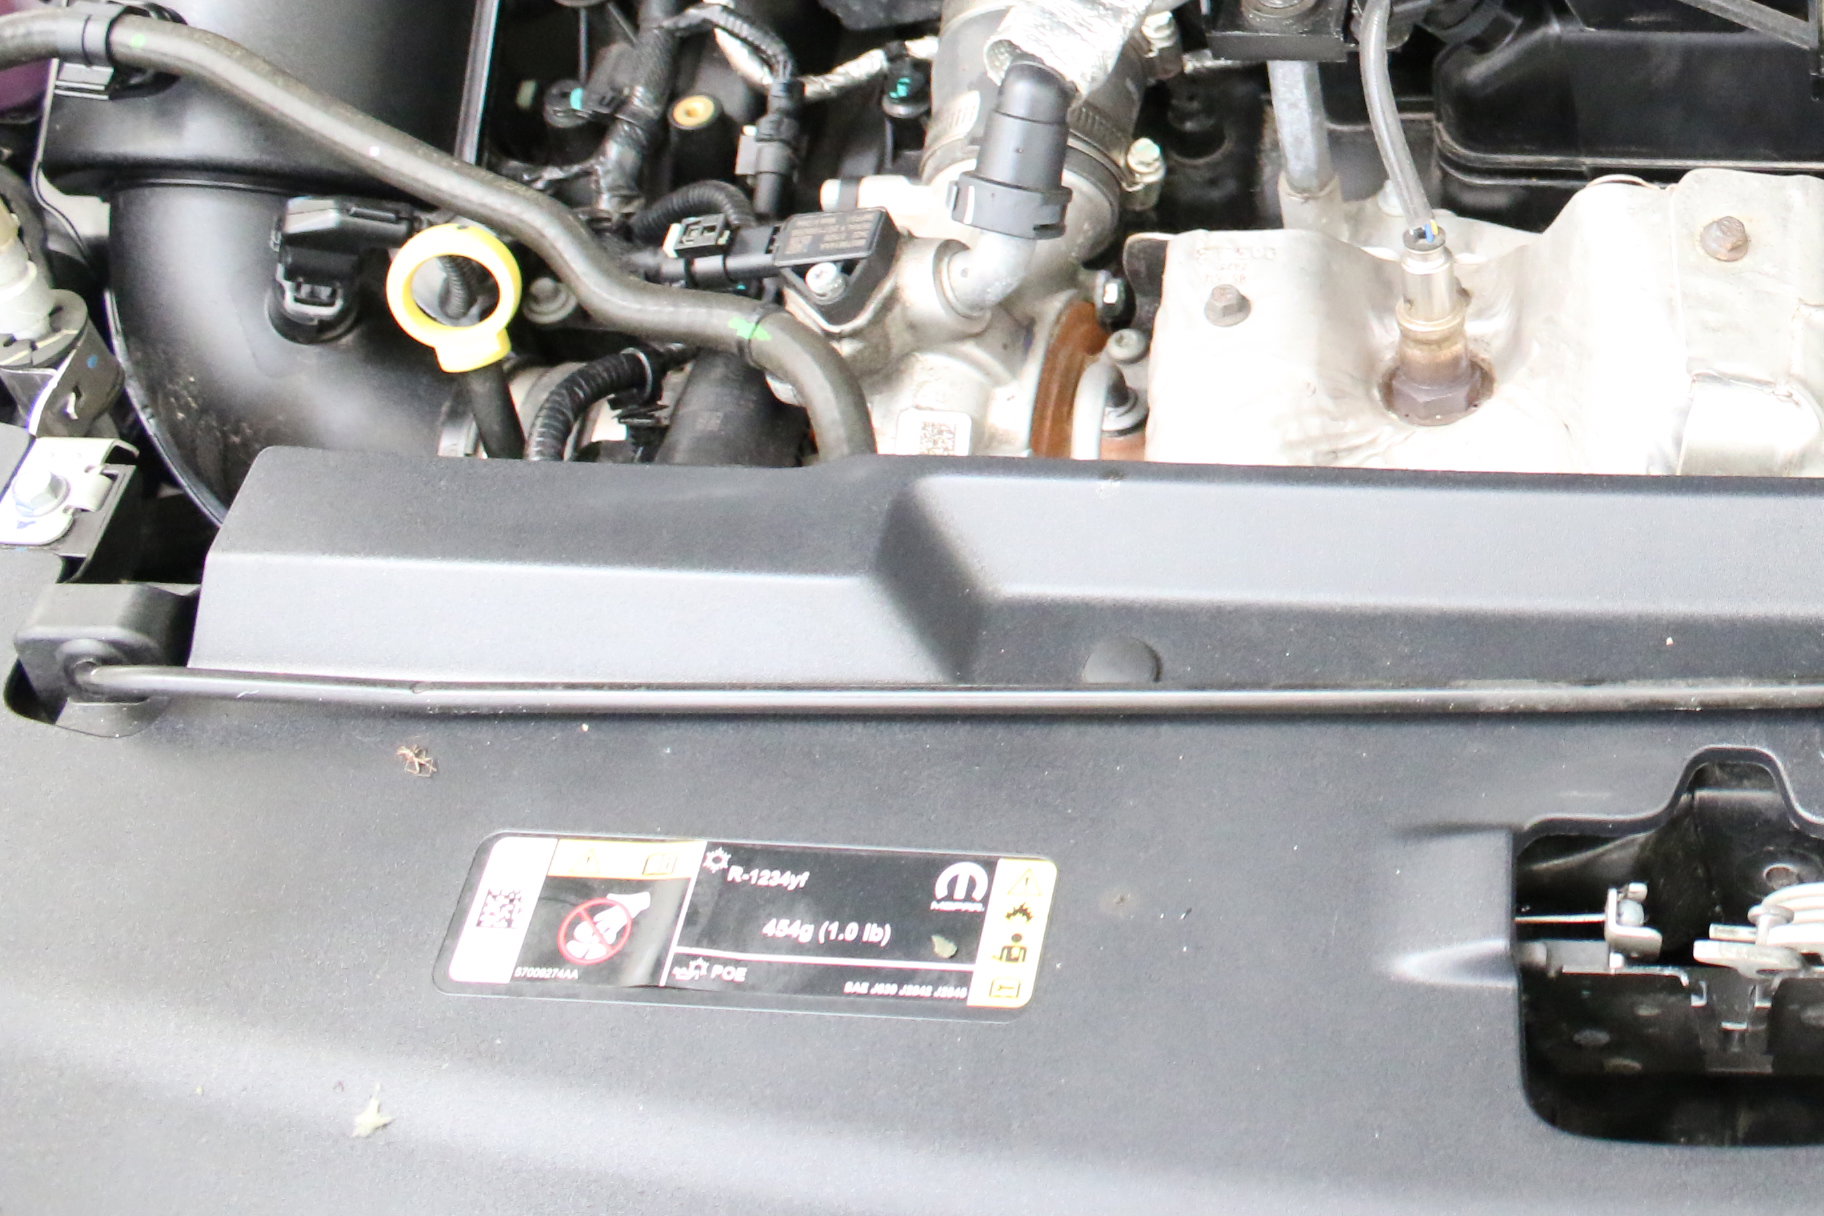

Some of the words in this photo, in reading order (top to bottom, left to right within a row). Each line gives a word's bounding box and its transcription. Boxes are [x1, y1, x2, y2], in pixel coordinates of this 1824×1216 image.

[727, 864, 811, 892] R-1234yf
[762, 917, 815, 943] 454g
[818, 921, 860, 944] (1.0
[861, 921, 892, 948] lb)
[710, 966, 748, 983] POE
